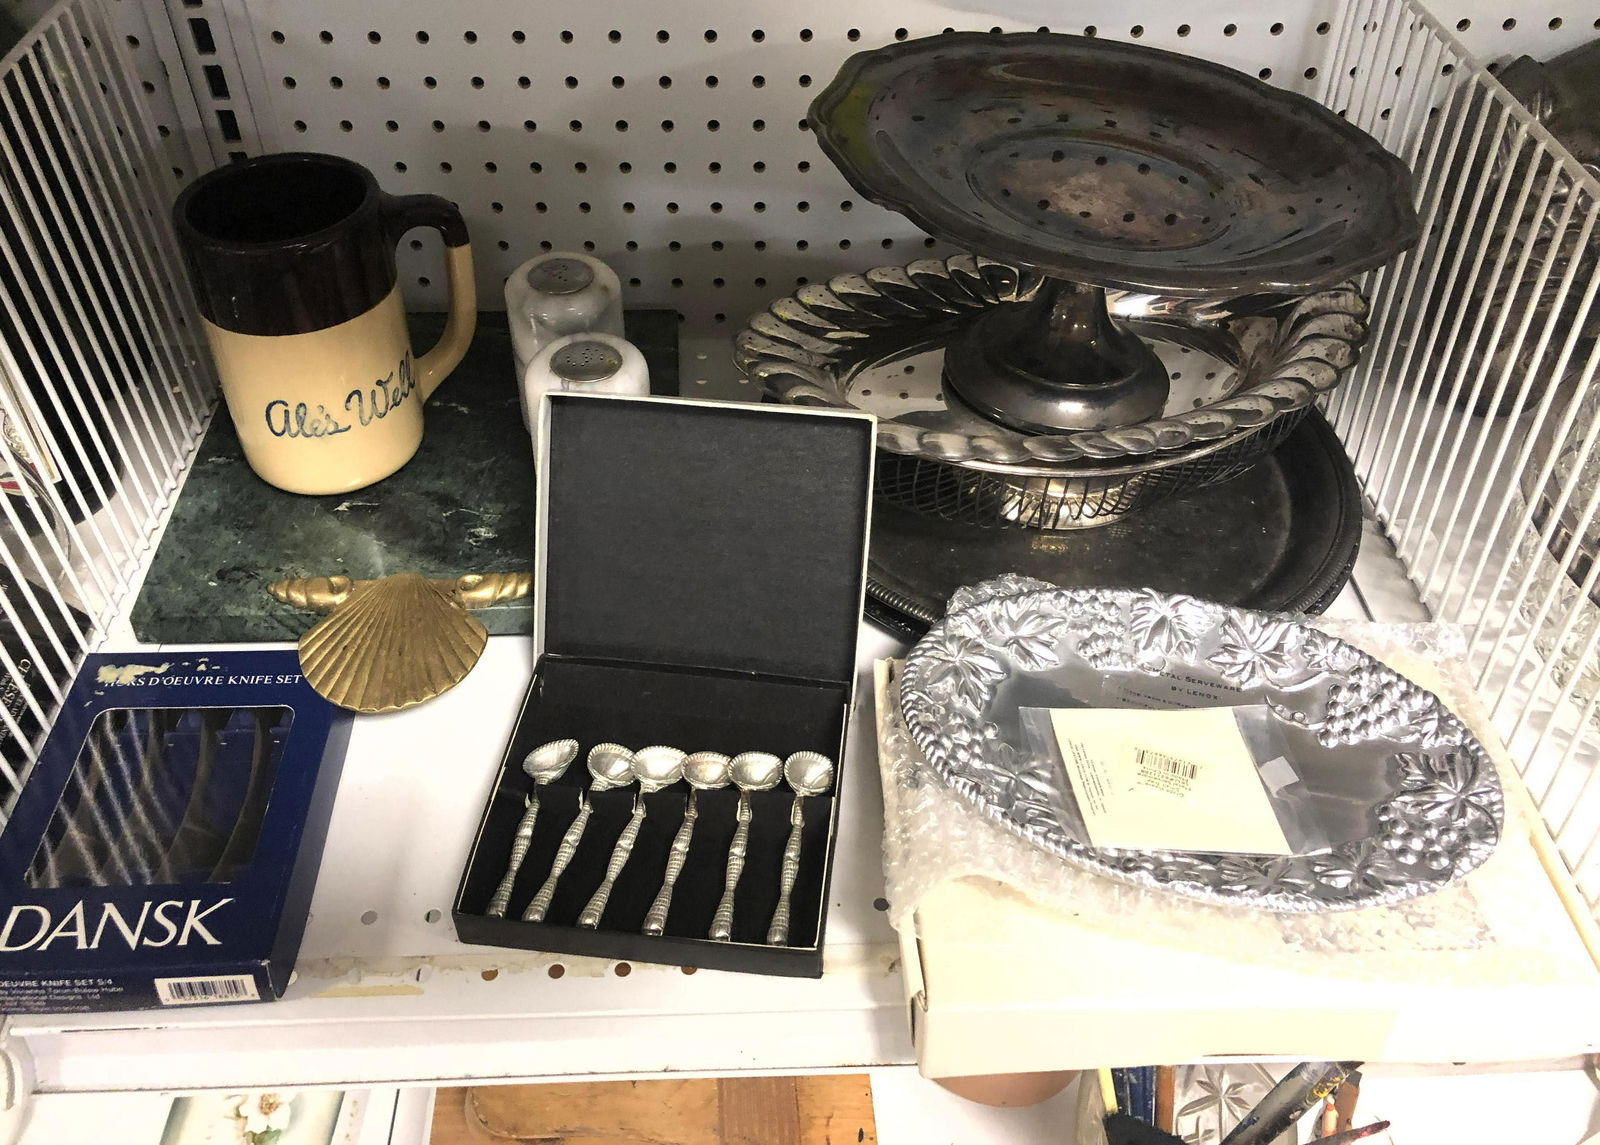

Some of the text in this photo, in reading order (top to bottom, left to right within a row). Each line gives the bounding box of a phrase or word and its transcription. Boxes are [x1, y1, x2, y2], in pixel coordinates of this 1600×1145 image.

[148, 675, 225, 686] D'OEUVRE
[227, 674, 274, 685] KNIFE
[275, 674, 303, 684] SET
[1187, 688, 1219, 701] LENOX
[0, 897, 235, 951] DANSK
[74, 979, 94, 987] SET
